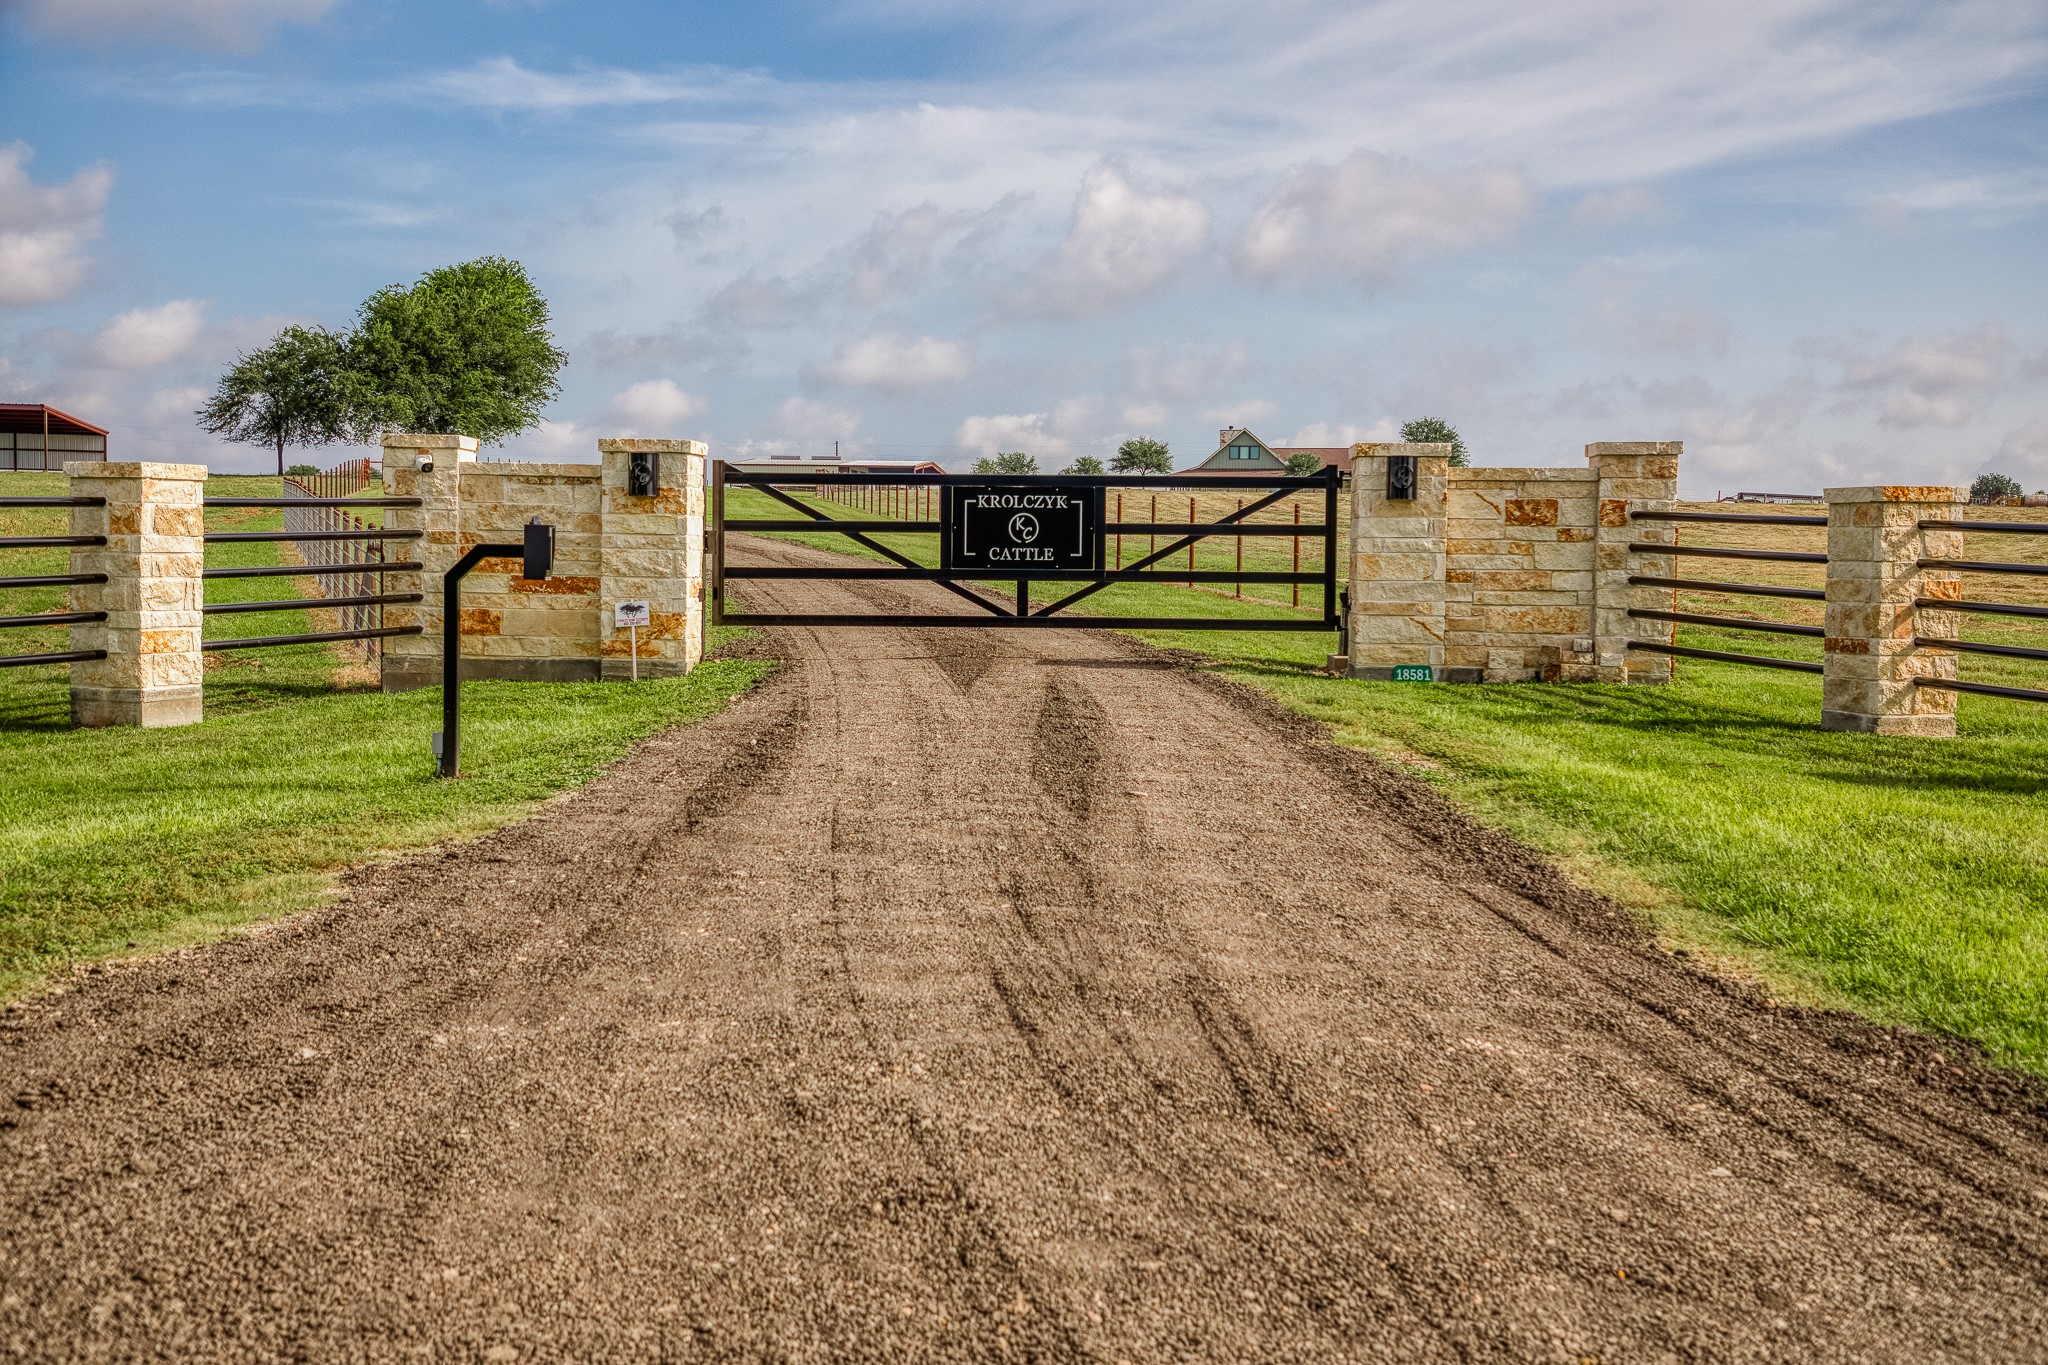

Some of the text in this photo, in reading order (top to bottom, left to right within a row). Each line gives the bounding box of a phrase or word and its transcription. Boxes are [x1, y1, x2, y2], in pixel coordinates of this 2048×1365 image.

[977, 495, 1068, 509] KROLCZYK
[1015, 517, 1033, 540] KC
[989, 547, 1054, 561] CATTLE
[1396, 668, 1431, 681] 18581
